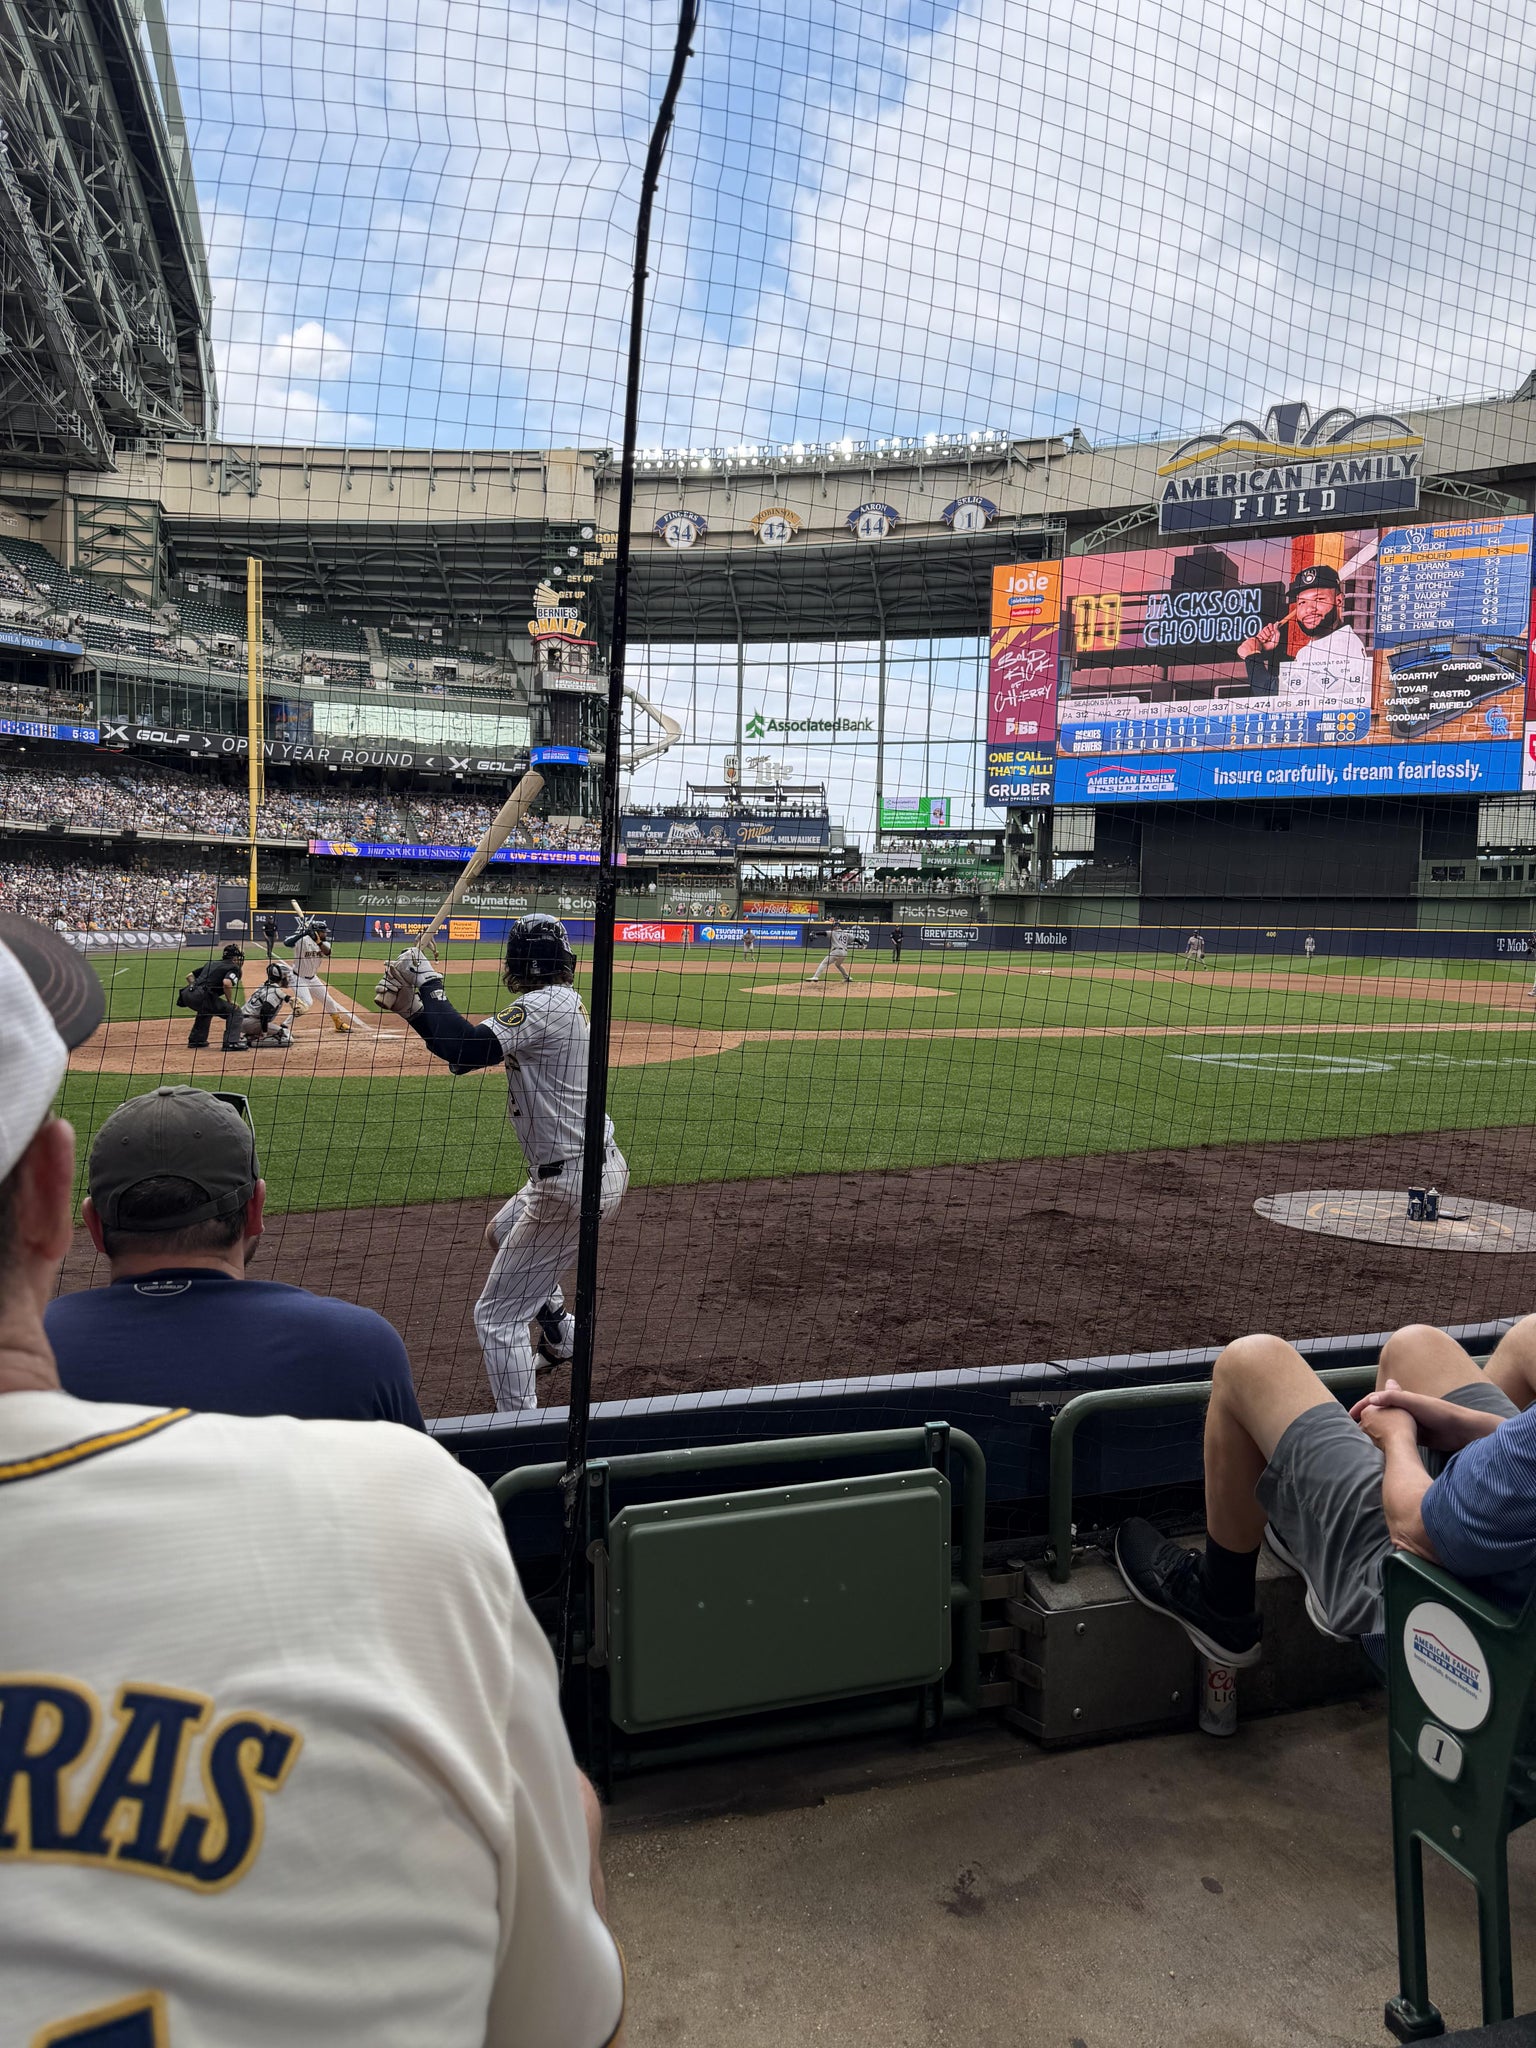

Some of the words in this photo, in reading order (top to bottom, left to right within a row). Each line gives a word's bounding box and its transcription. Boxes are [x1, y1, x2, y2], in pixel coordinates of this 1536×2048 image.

[1164, 467, 1302, 500] AMERICAN
[1315, 454, 1417, 485] FAMILY
[860, 503, 887, 512] AARON
[957, 497, 982, 506] SELIG
[1235, 489, 1335, 519] FIELD
[663, 511, 699, 522] FINGERS
[756, 507, 797, 523] ROBINSON
[966, 512, 973, 529] 1
[669, 526, 691, 541] 34
[764, 525, 786, 539] 42
[861, 520, 882, 535] 44
[1434, 527, 1472, 538] BREWERS
[1417, 552, 1451, 561] CHOURIO
[1416, 562, 1449, 571] TURANG
[1005, 571, 1048, 593] Joie
[1416, 571, 1464, 581] CONTRERAS
[1415, 582, 1454, 590] MITCHELL
[1145, 588, 1262, 619] JACKSON
[1414, 602, 1446, 610] BAUERS
[537, 608, 577, 618] BERNIE'S
[1414, 611, 1437, 619] ORTIZ
[528, 619, 586, 637] CHALET
[1413, 620, 1454, 629] HAMILTON
[1143, 615, 1262, 647] CHOURIO
[21, 637, 43, 647] PATIO
[995, 649, 1046, 672] BOLD
[1442, 662, 1482, 671] CARRIGG
[1004, 659, 1054, 681] KICK
[1465, 673, 1514, 682] JOHNSTON
[1011, 680, 1026, 689] OF
[1397, 685, 1428, 693] TOVAR
[994, 684, 1052, 713] CHERRY
[1433, 690, 1471, 698] CASTRO
[1384, 697, 1420, 705] KARROS
[1430, 701, 1473, 710] RUMFIELD
[1386, 713, 1430, 722] GOODMAN
[767, 717, 874, 732] AssociatedBank
[72, 729, 95, 741] 5:33
[1075, 730, 1101, 740] ROCKIES
[1324, 733, 1335, 741] OUT
[136, 729, 191, 744] GOLF
[282, 743, 330, 762] YEAR
[342, 748, 414, 768] ROUND
[477, 760, 527, 773] GOLF
[1073, 741, 1102, 752] BREWERS
[989, 752, 1013, 762] ONE
[1016, 751, 1052, 762] CALL...
[757, 762, 794, 785] Lite
[988, 765, 1026, 777] THAT'S
[1029, 764, 1053, 775] ALL!
[1214, 766, 1262, 785] Insure
[1266, 765, 1339, 786] carefully,
[1343, 764, 1393, 782] dream
[1398, 760, 1483, 780] fearlessly.
[1088, 775, 1137, 786] AMERICAN
[1139, 772, 1176, 785] FAMILY
[989, 783, 1050, 796] GRUBER
[1093, 783, 1169, 792] INSURANCE
[737, 825, 775, 842] Miller
[778, 835, 821, 844] MILWAUKEE
[386, 846, 416, 855] SPORT
[419, 848, 461, 857] BUSINESS
[926, 857, 952, 865] POWER
[954, 857, 975, 865] ALLEY
[358, 894, 393, 907] Tito's
[462, 895, 527, 906] Polymatech
[670, 888, 722, 902] Johnsonville
[751, 903, 789, 915] Surfside
[937, 906, 968, 918] Save
[622, 927, 665, 940] festival
[1035, 932, 1068, 944] Mobile
[1414, 1634, 1450, 1662] AMERICAN
[1453, 1659, 1479, 1680] FAMILY
[1418, 1645, 1474, 1686] INSURANCE
[1431, 1738, 1445, 1765] 1
[0, 1670, 303, 1897] RAS
